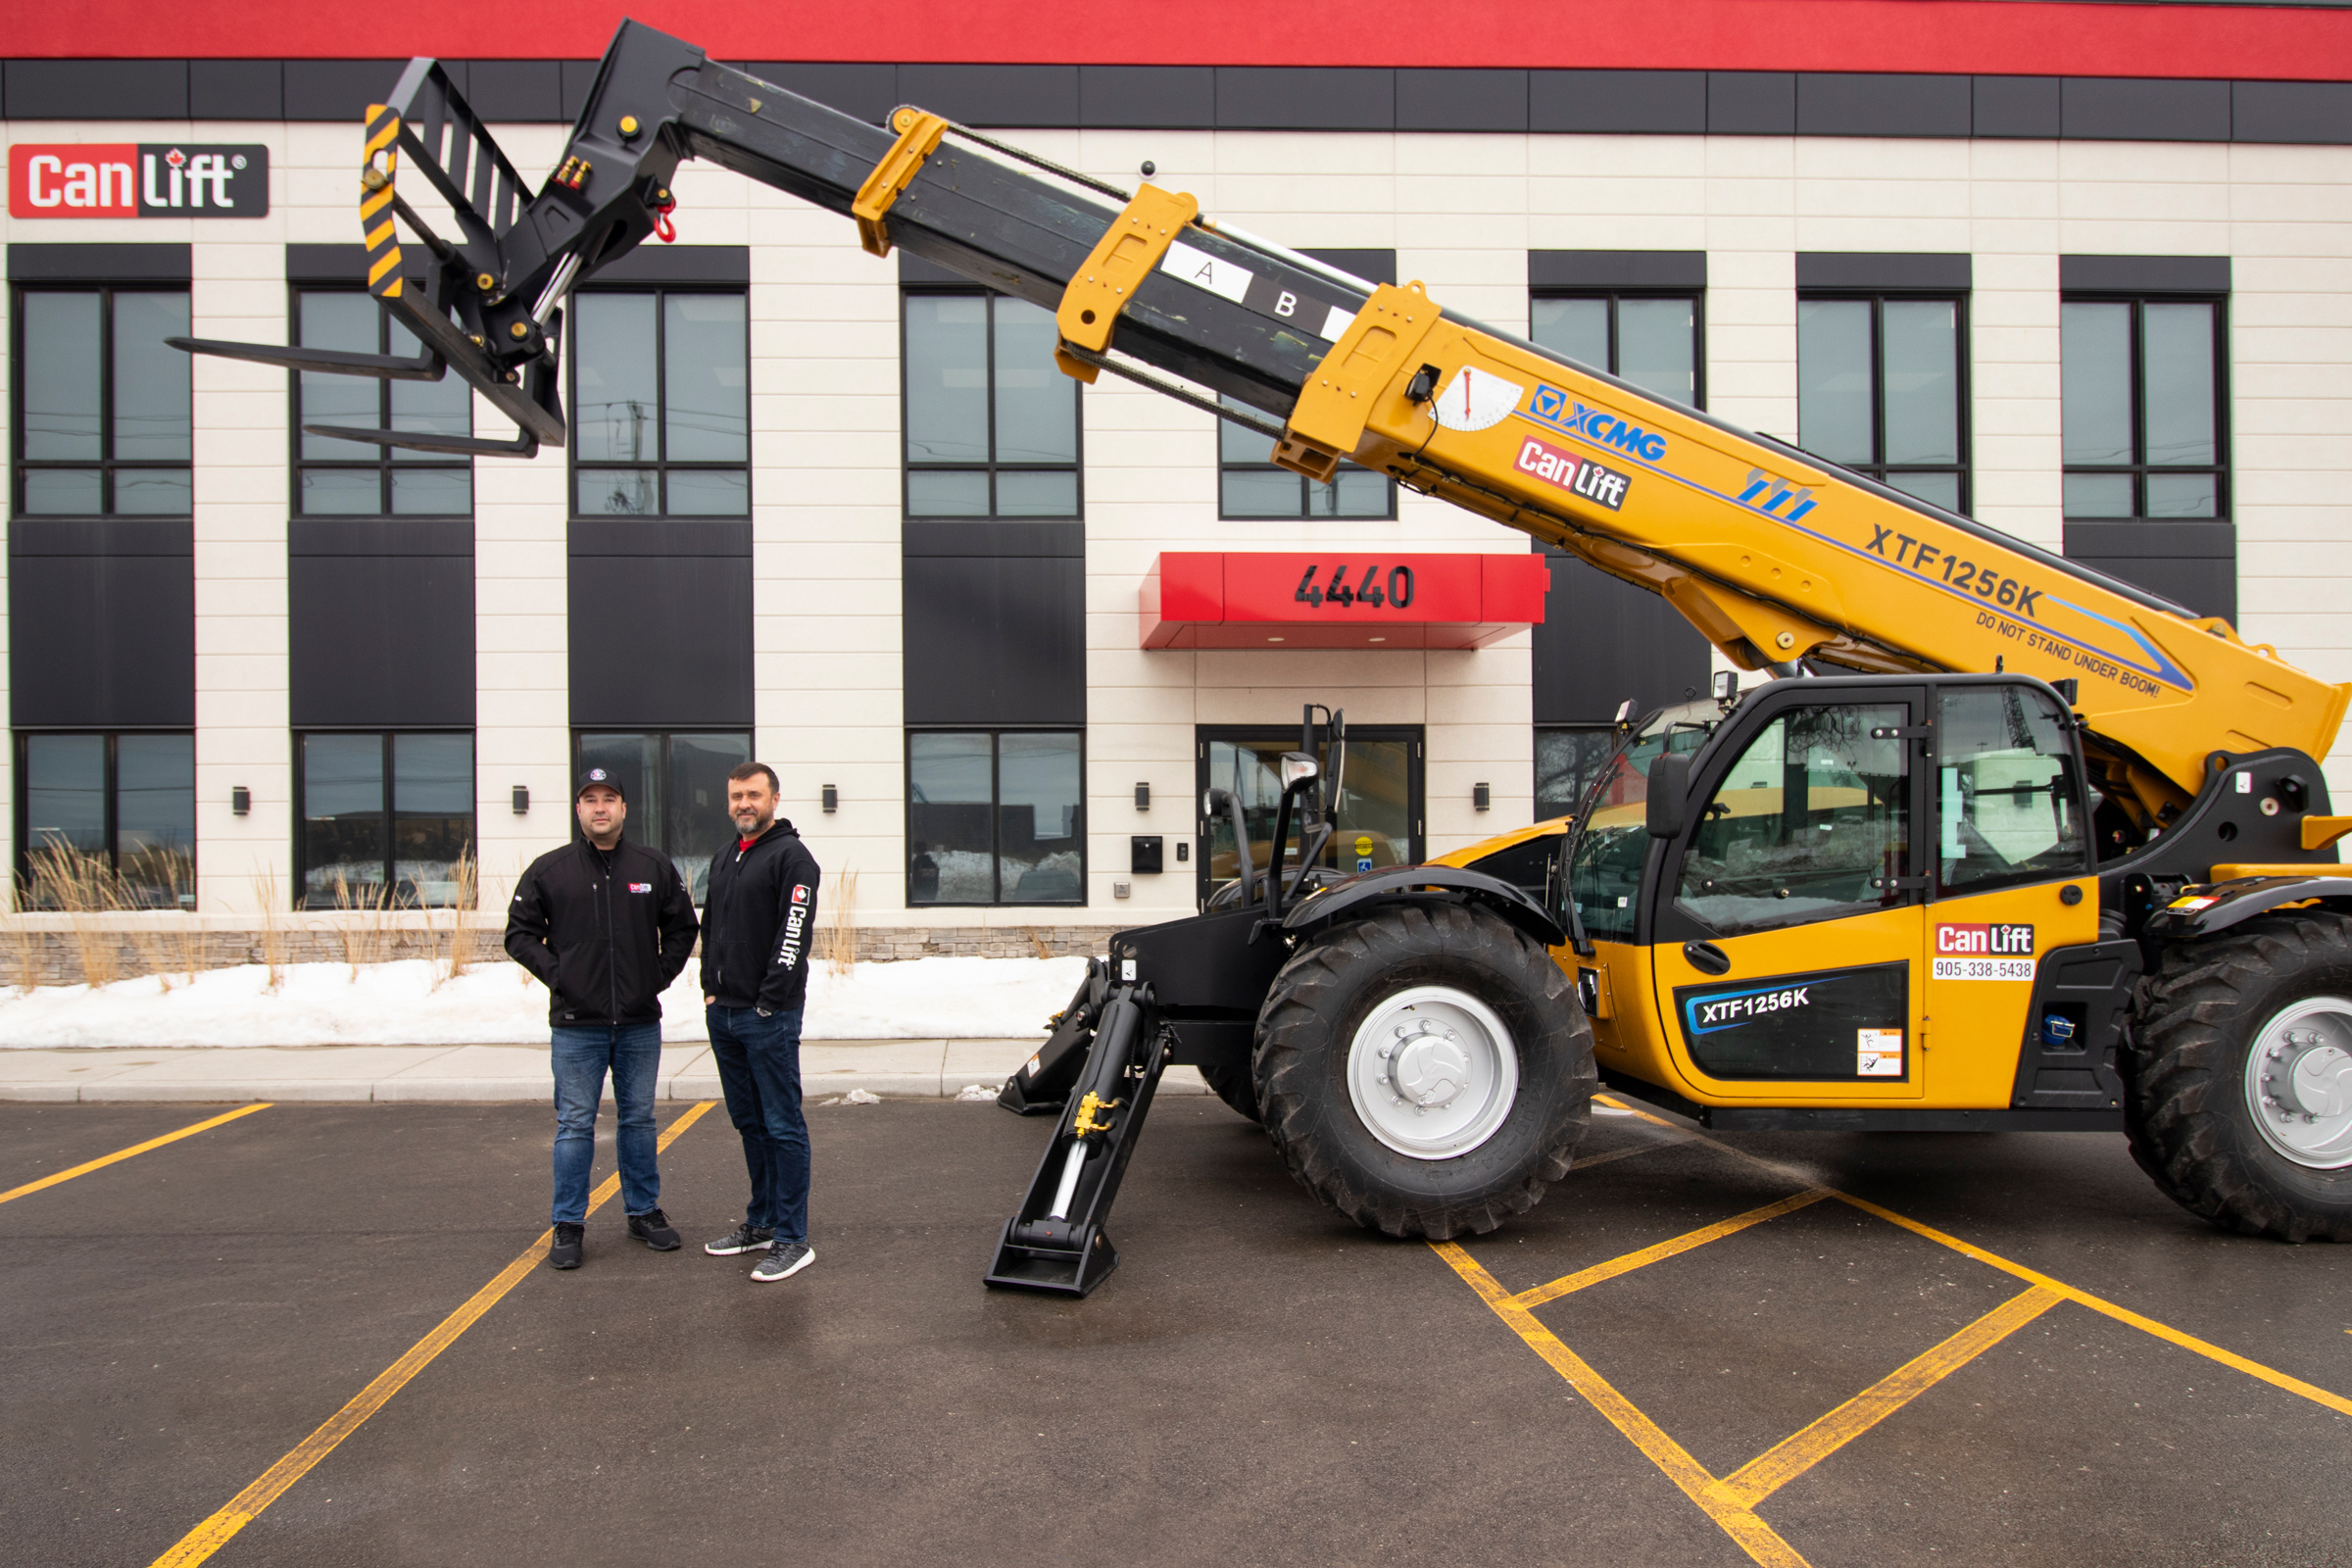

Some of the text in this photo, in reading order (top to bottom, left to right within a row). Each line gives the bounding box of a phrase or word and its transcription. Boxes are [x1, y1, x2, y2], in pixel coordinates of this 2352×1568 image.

[1194, 261, 1298, 318] A B
[1558, 401, 1667, 462] XCMG
[1295, 564, 1414, 609] 4440
[1865, 522, 2044, 617] XTF1256K
[1976, 612, 2161, 699] DO NOT STAND UNDER BOOM!
[1936, 961, 2032, 977] 905-338-5438
[1702, 987, 1810, 1023] XTF1256K
